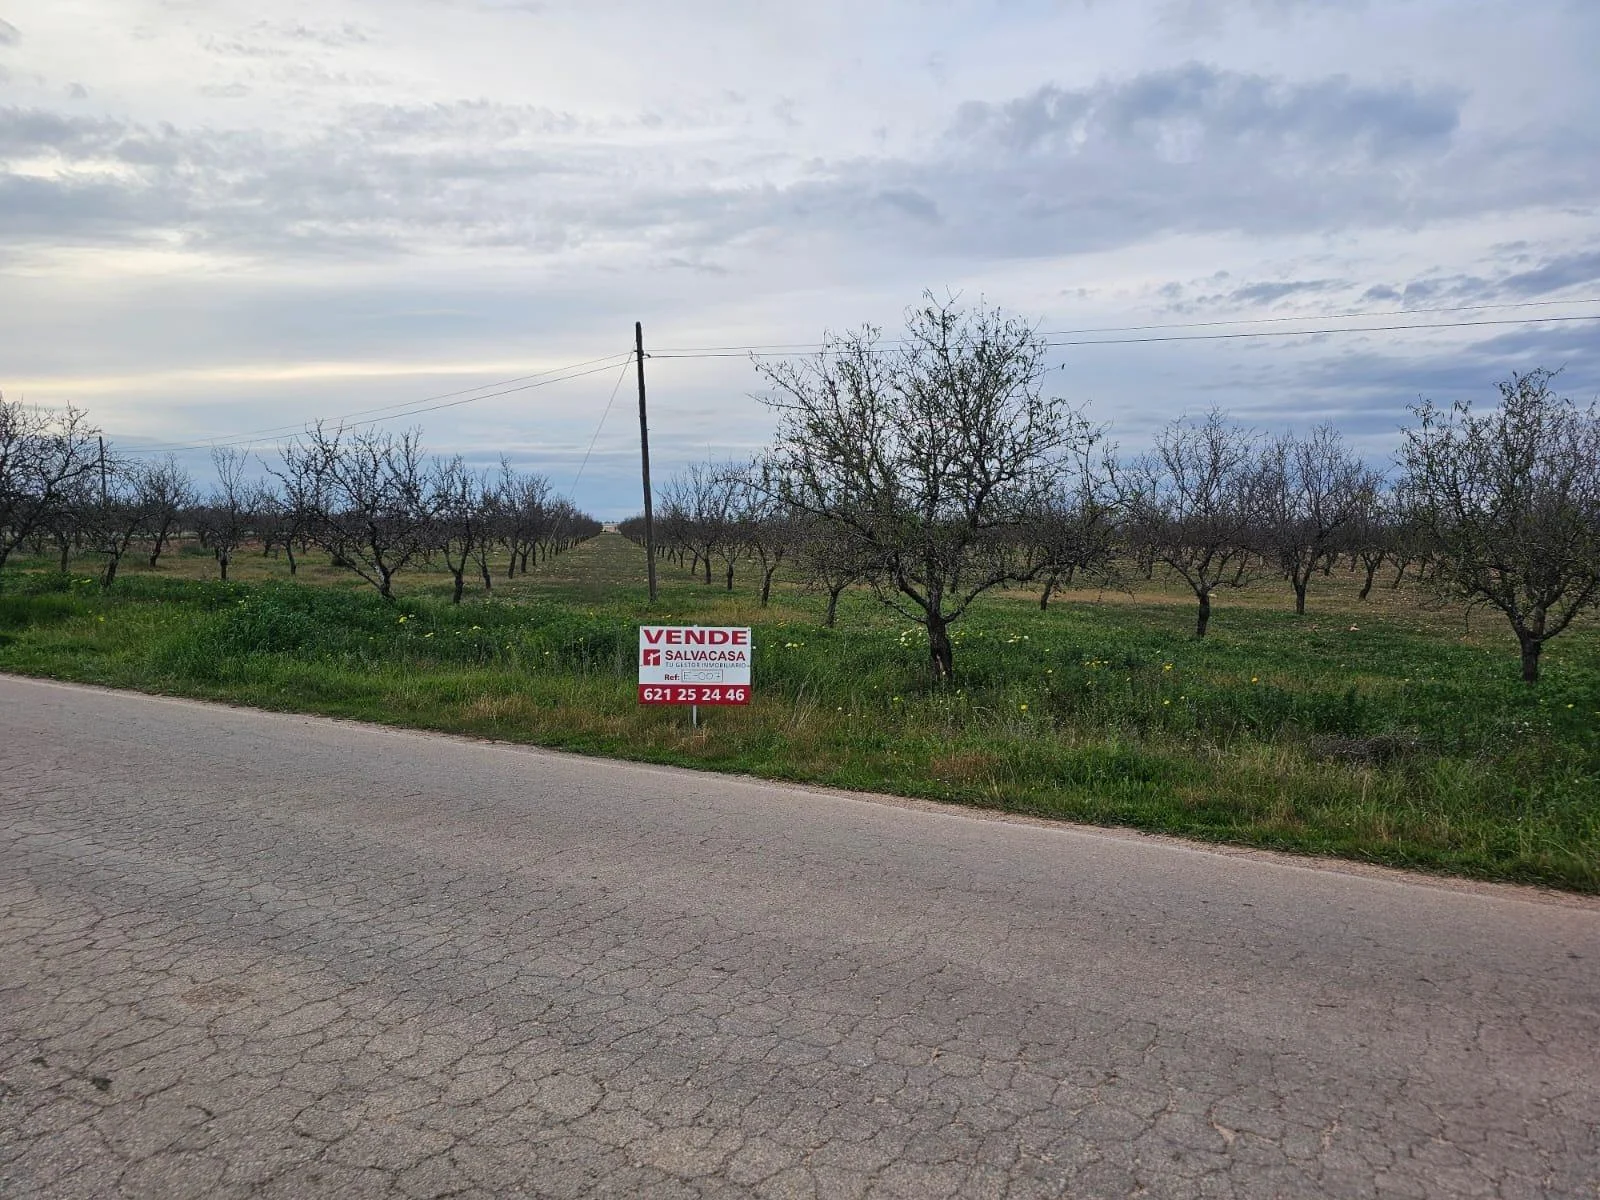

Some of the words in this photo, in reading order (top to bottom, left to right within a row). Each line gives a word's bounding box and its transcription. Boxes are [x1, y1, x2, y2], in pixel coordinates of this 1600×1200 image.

[643, 629, 748, 645] VENDE
[665, 650, 746, 661] SALVACASA
[643, 688, 671, 701] 621
[678, 688, 697, 701] 25
[702, 688, 721, 701] 24
[725, 688, 745, 701] 46
